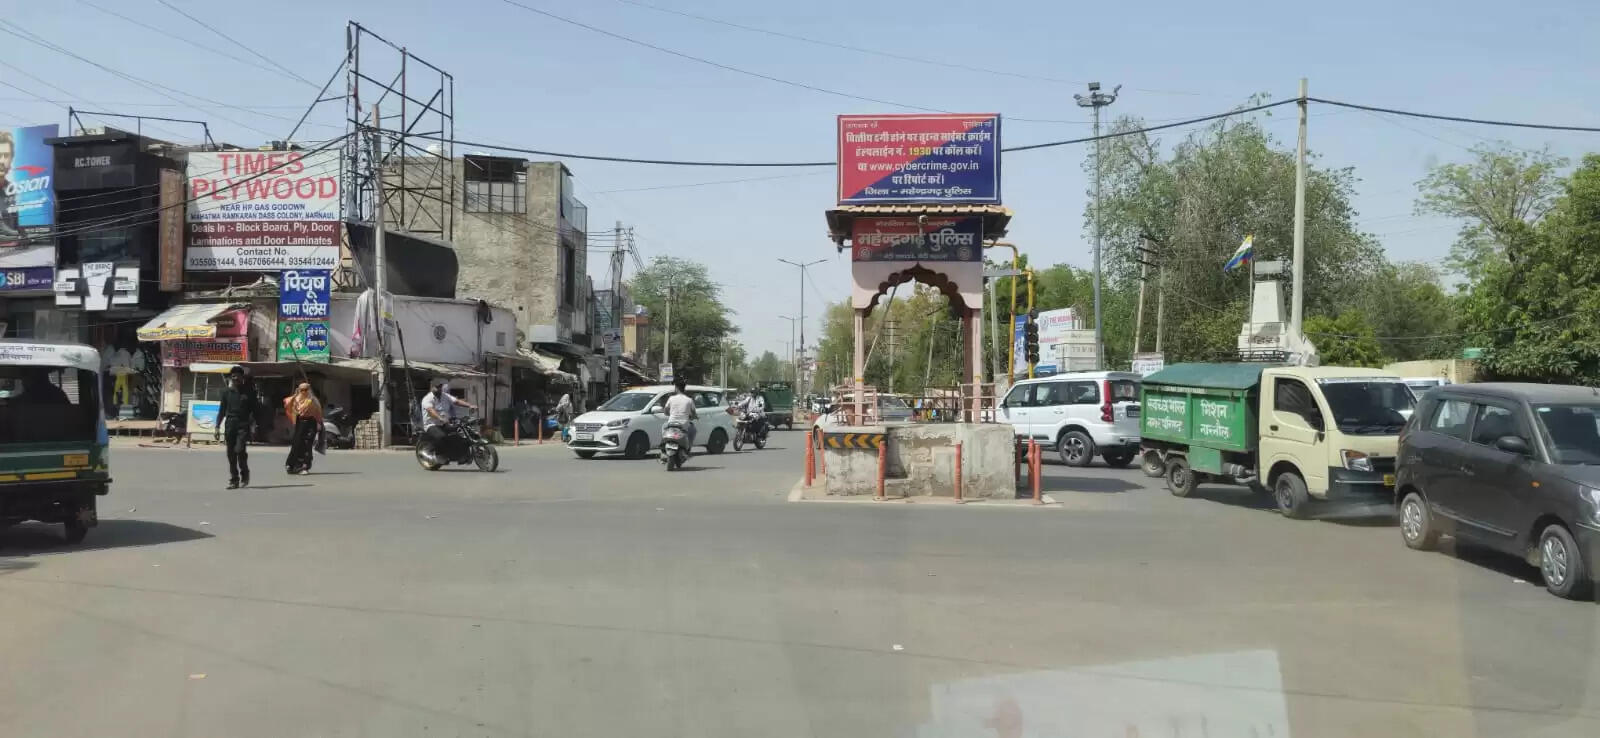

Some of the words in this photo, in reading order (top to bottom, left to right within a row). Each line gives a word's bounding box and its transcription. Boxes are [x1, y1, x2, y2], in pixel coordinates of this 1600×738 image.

[906, 133, 918, 142] पर
[909, 146, 931, 156] 1930
[932, 146, 944, 156] पर
[944, 144, 964, 156] कॉल
[217, 151, 304, 175] TIMES
[858, 162, 867, 172] या
[869, 160, 979, 173] www.cybercrime.gov.in
[892, 175, 903, 185] पर
[903, 173, 927, 185] रिपोर्ट
[191, 176, 337, 200] PLYWOOD
[944, 186, 973, 198] पुलिस
[254, 203, 270, 211] GAS
[271, 203, 305, 211] GODOWN
[305, 211, 335, 219] NARNAUL
[191, 223, 215, 233] Deals
[217, 223, 226, 233] In
[236, 222, 261, 232] Block
[262, 222, 291, 233] Board,
[293, 222, 309, 233] Ply,
[311, 222, 335, 233] Door,
[191, 235, 243, 246] Laminations
[245, 235, 262, 246] and
[263, 235, 286, 245] Door
[287, 235, 333, 245] Laminates
[929, 227, 975, 252] पुलिस
[236, 247, 273, 256] Contact
[288, 256, 335, 266] 9354412444
[7, 272, 25, 285] SBI
[284, 270, 326, 299] पियूष
[302, 299, 327, 316] पैलेस
[1200, 399, 1228, 418] मिशन
[1200, 418, 1231, 439] नारनौल
